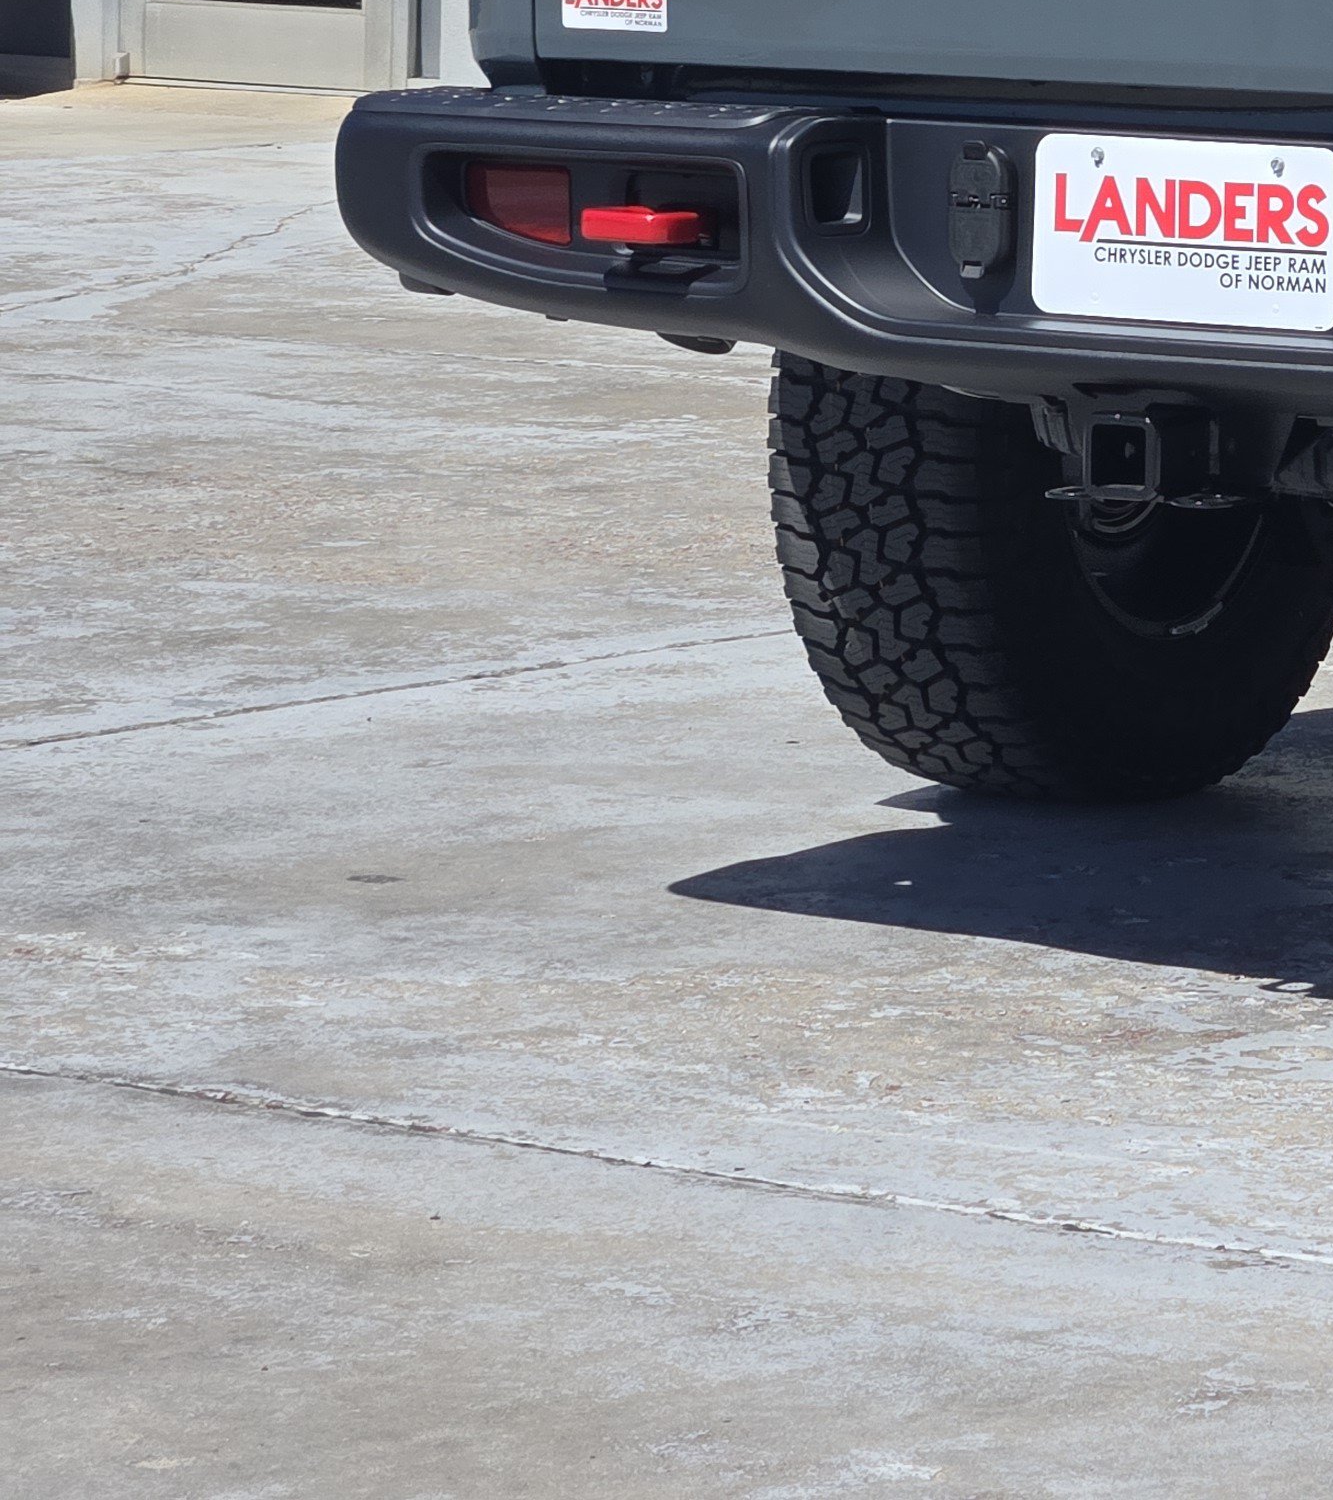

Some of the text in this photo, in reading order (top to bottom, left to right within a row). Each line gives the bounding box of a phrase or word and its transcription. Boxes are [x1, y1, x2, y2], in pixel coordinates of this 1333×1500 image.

[1054, 172, 1330, 248] LANDERS
[1094, 246, 1327, 275] CHRYSLER DODGE JEEP RAM
[1219, 273, 1327, 294] OF NORMAN
